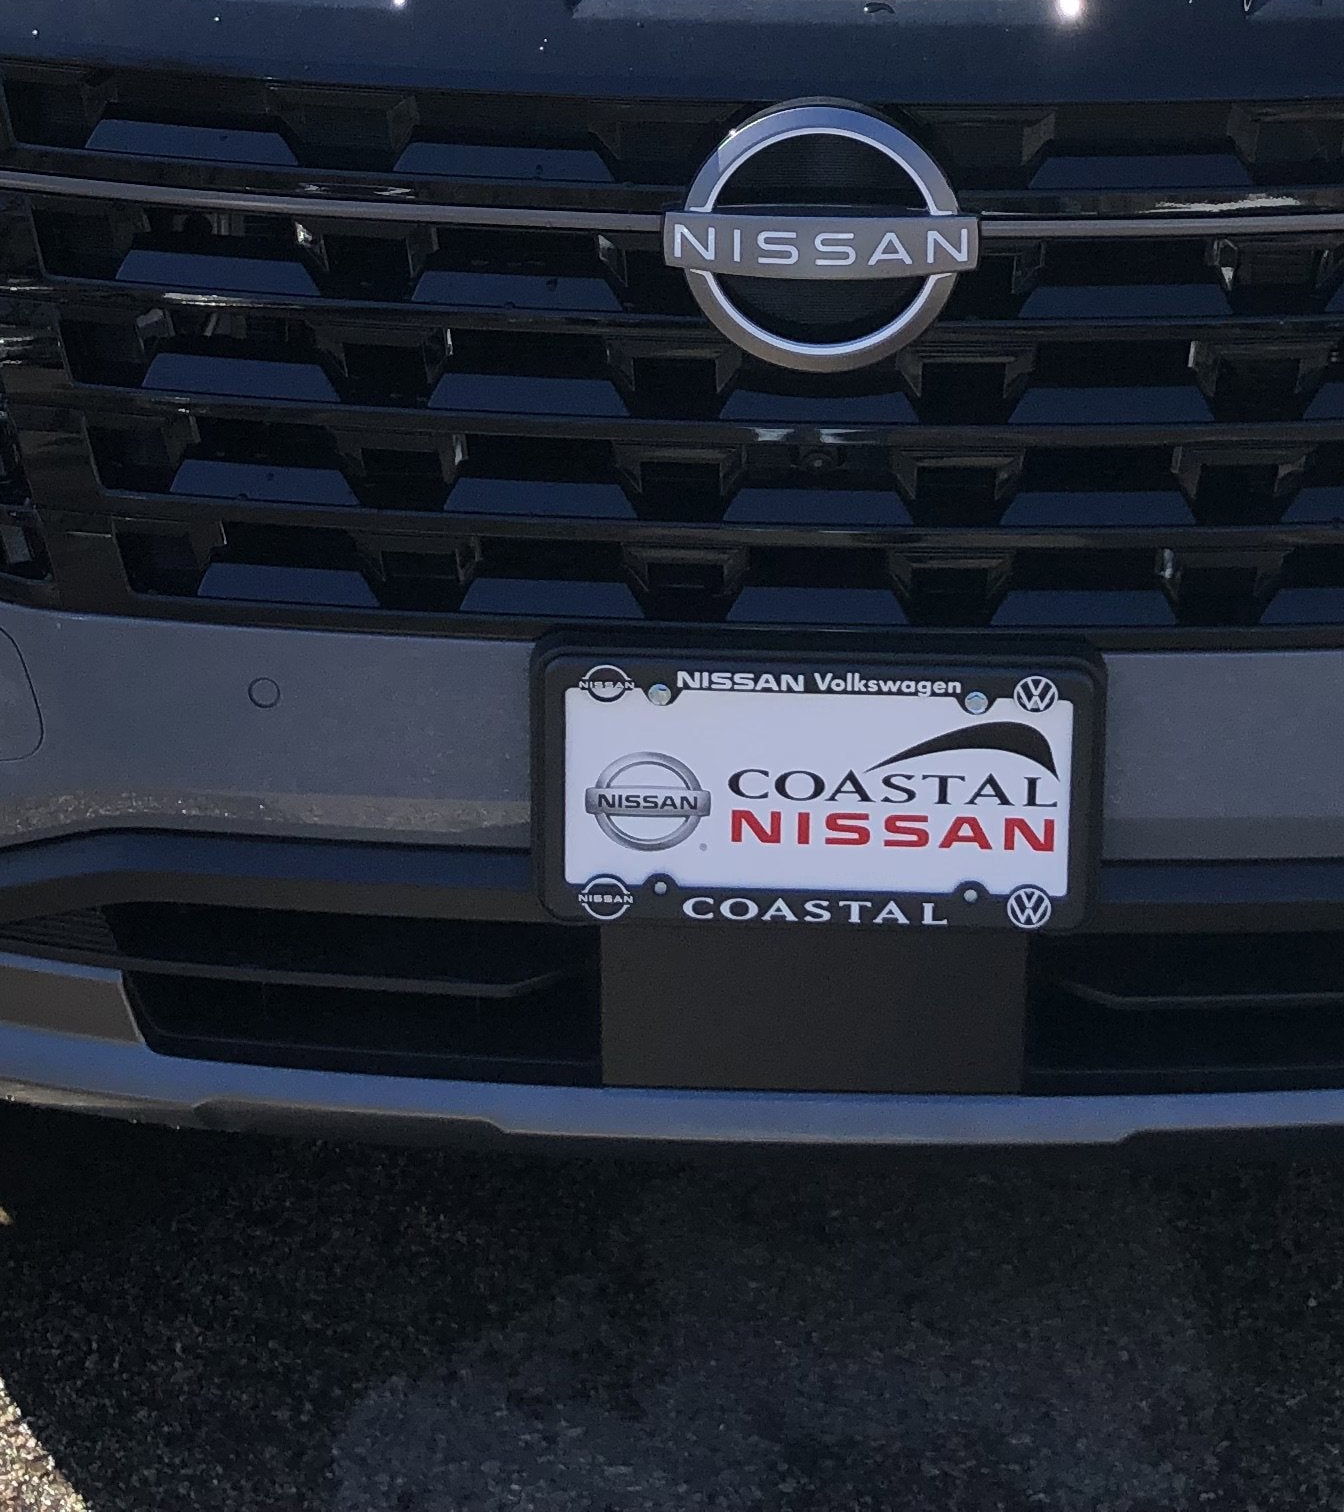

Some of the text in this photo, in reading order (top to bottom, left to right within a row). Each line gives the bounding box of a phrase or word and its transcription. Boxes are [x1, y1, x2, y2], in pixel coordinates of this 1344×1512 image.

[673, 224, 969, 266] NISSAN
[579, 680, 635, 689] NISSAN
[676, 670, 962, 697] NISSAN Volkswagen
[597, 791, 698, 811] NISSAN
[727, 769, 1058, 808] COASTAL
[730, 810, 1055, 852] NISSAN
[578, 894, 634, 904] NISSAN
[682, 896, 948, 925] COASTAL
